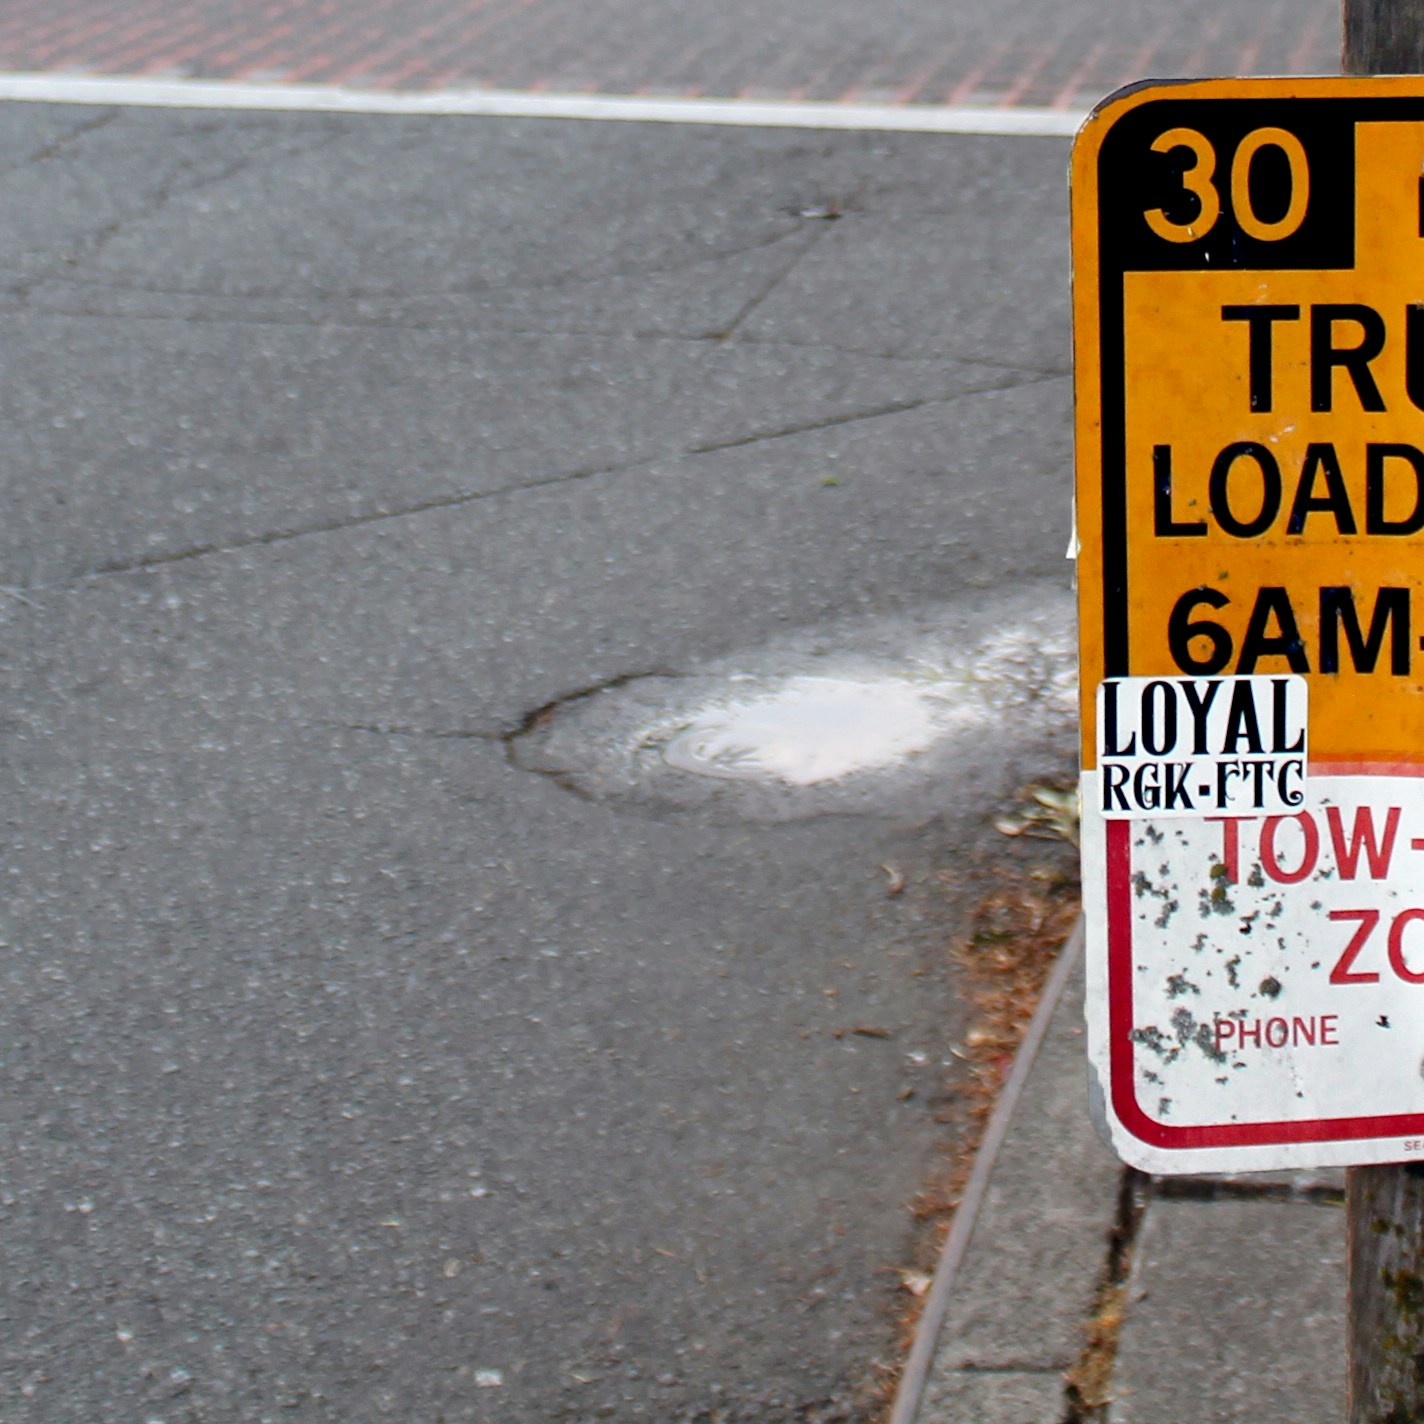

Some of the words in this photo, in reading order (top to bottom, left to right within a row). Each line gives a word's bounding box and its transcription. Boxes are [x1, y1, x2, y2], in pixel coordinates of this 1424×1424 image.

[1142, 126, 1311, 244] 30
[1102, 679, 1305, 758] LOYAL
[1214, 1014, 1339, 1051] PHONE
